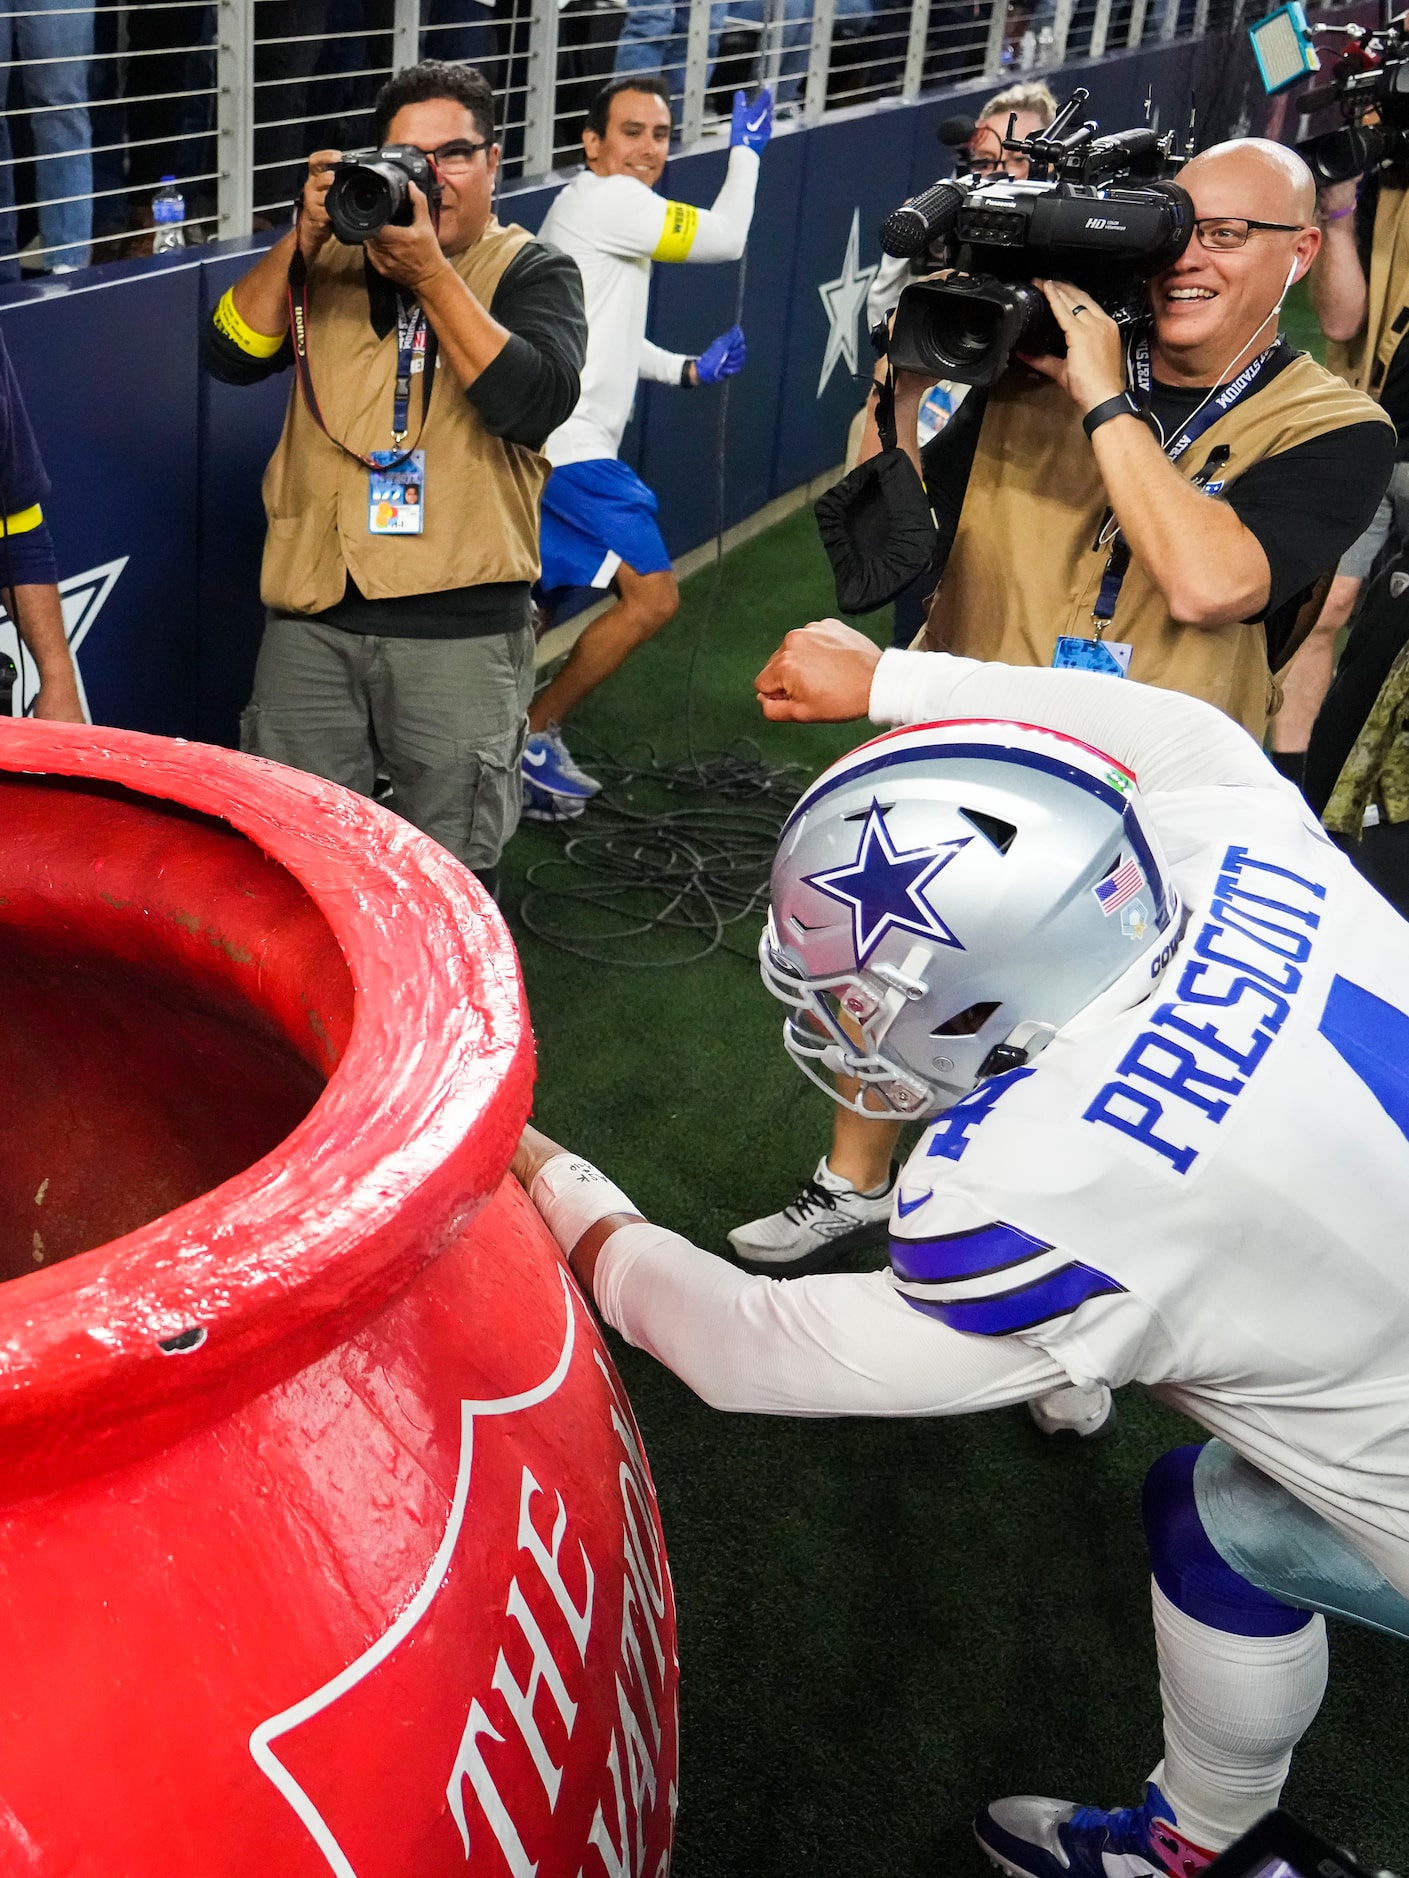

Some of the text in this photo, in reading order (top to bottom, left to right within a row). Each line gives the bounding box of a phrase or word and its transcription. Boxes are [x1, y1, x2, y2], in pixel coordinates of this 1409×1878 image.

[1085, 217, 1107, 229] HD
[294, 306, 306, 357] Canon
[1138, 363, 1150, 392] AT&T
[1216, 359, 1261, 409] STADIUM
[1081, 845, 1327, 1175] PRESCOTT
[926, 1066, 1039, 1162] 4
[445, 1465, 596, 1878] THE
